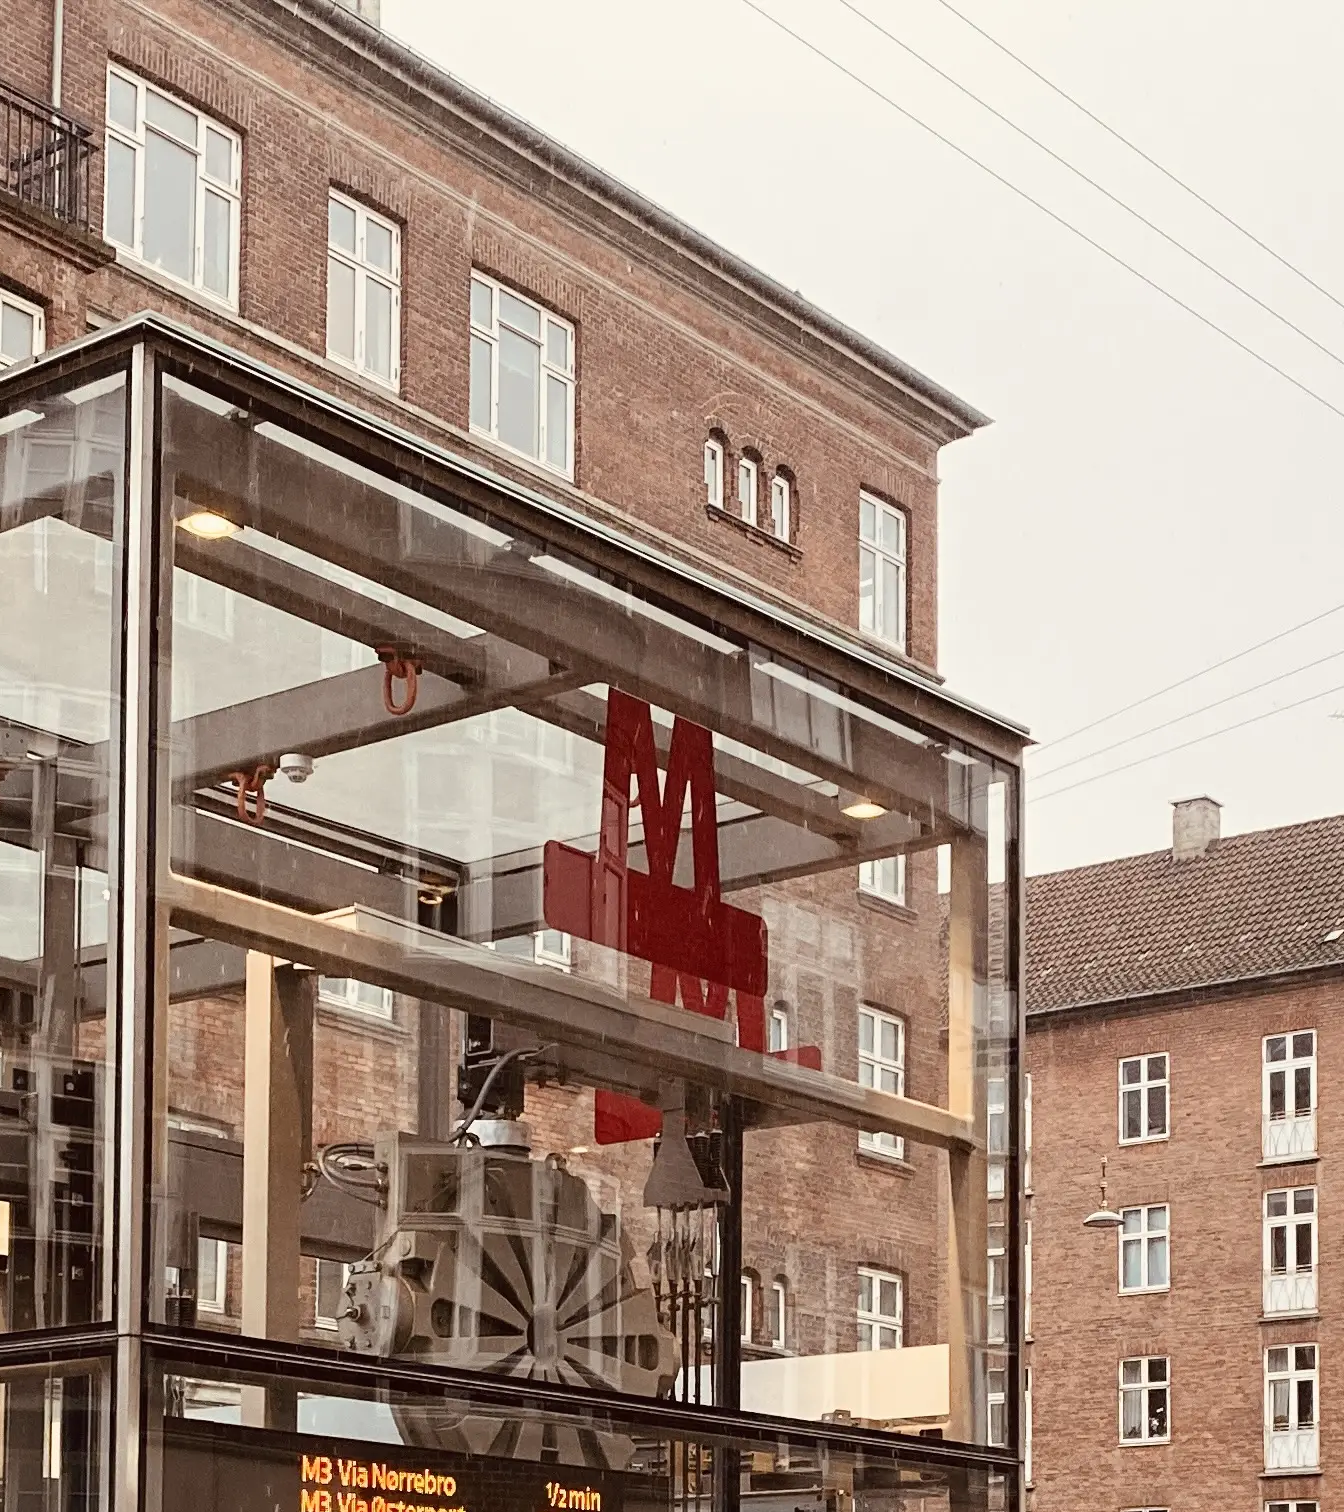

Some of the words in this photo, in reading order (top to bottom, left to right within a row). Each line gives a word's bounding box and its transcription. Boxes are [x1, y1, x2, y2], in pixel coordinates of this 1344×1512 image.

[301, 1455, 333, 1485] M3
[337, 1458, 369, 1489] Via
[372, 1462, 456, 1497] Nørrebro
[569, 1486, 601, 1512] min
